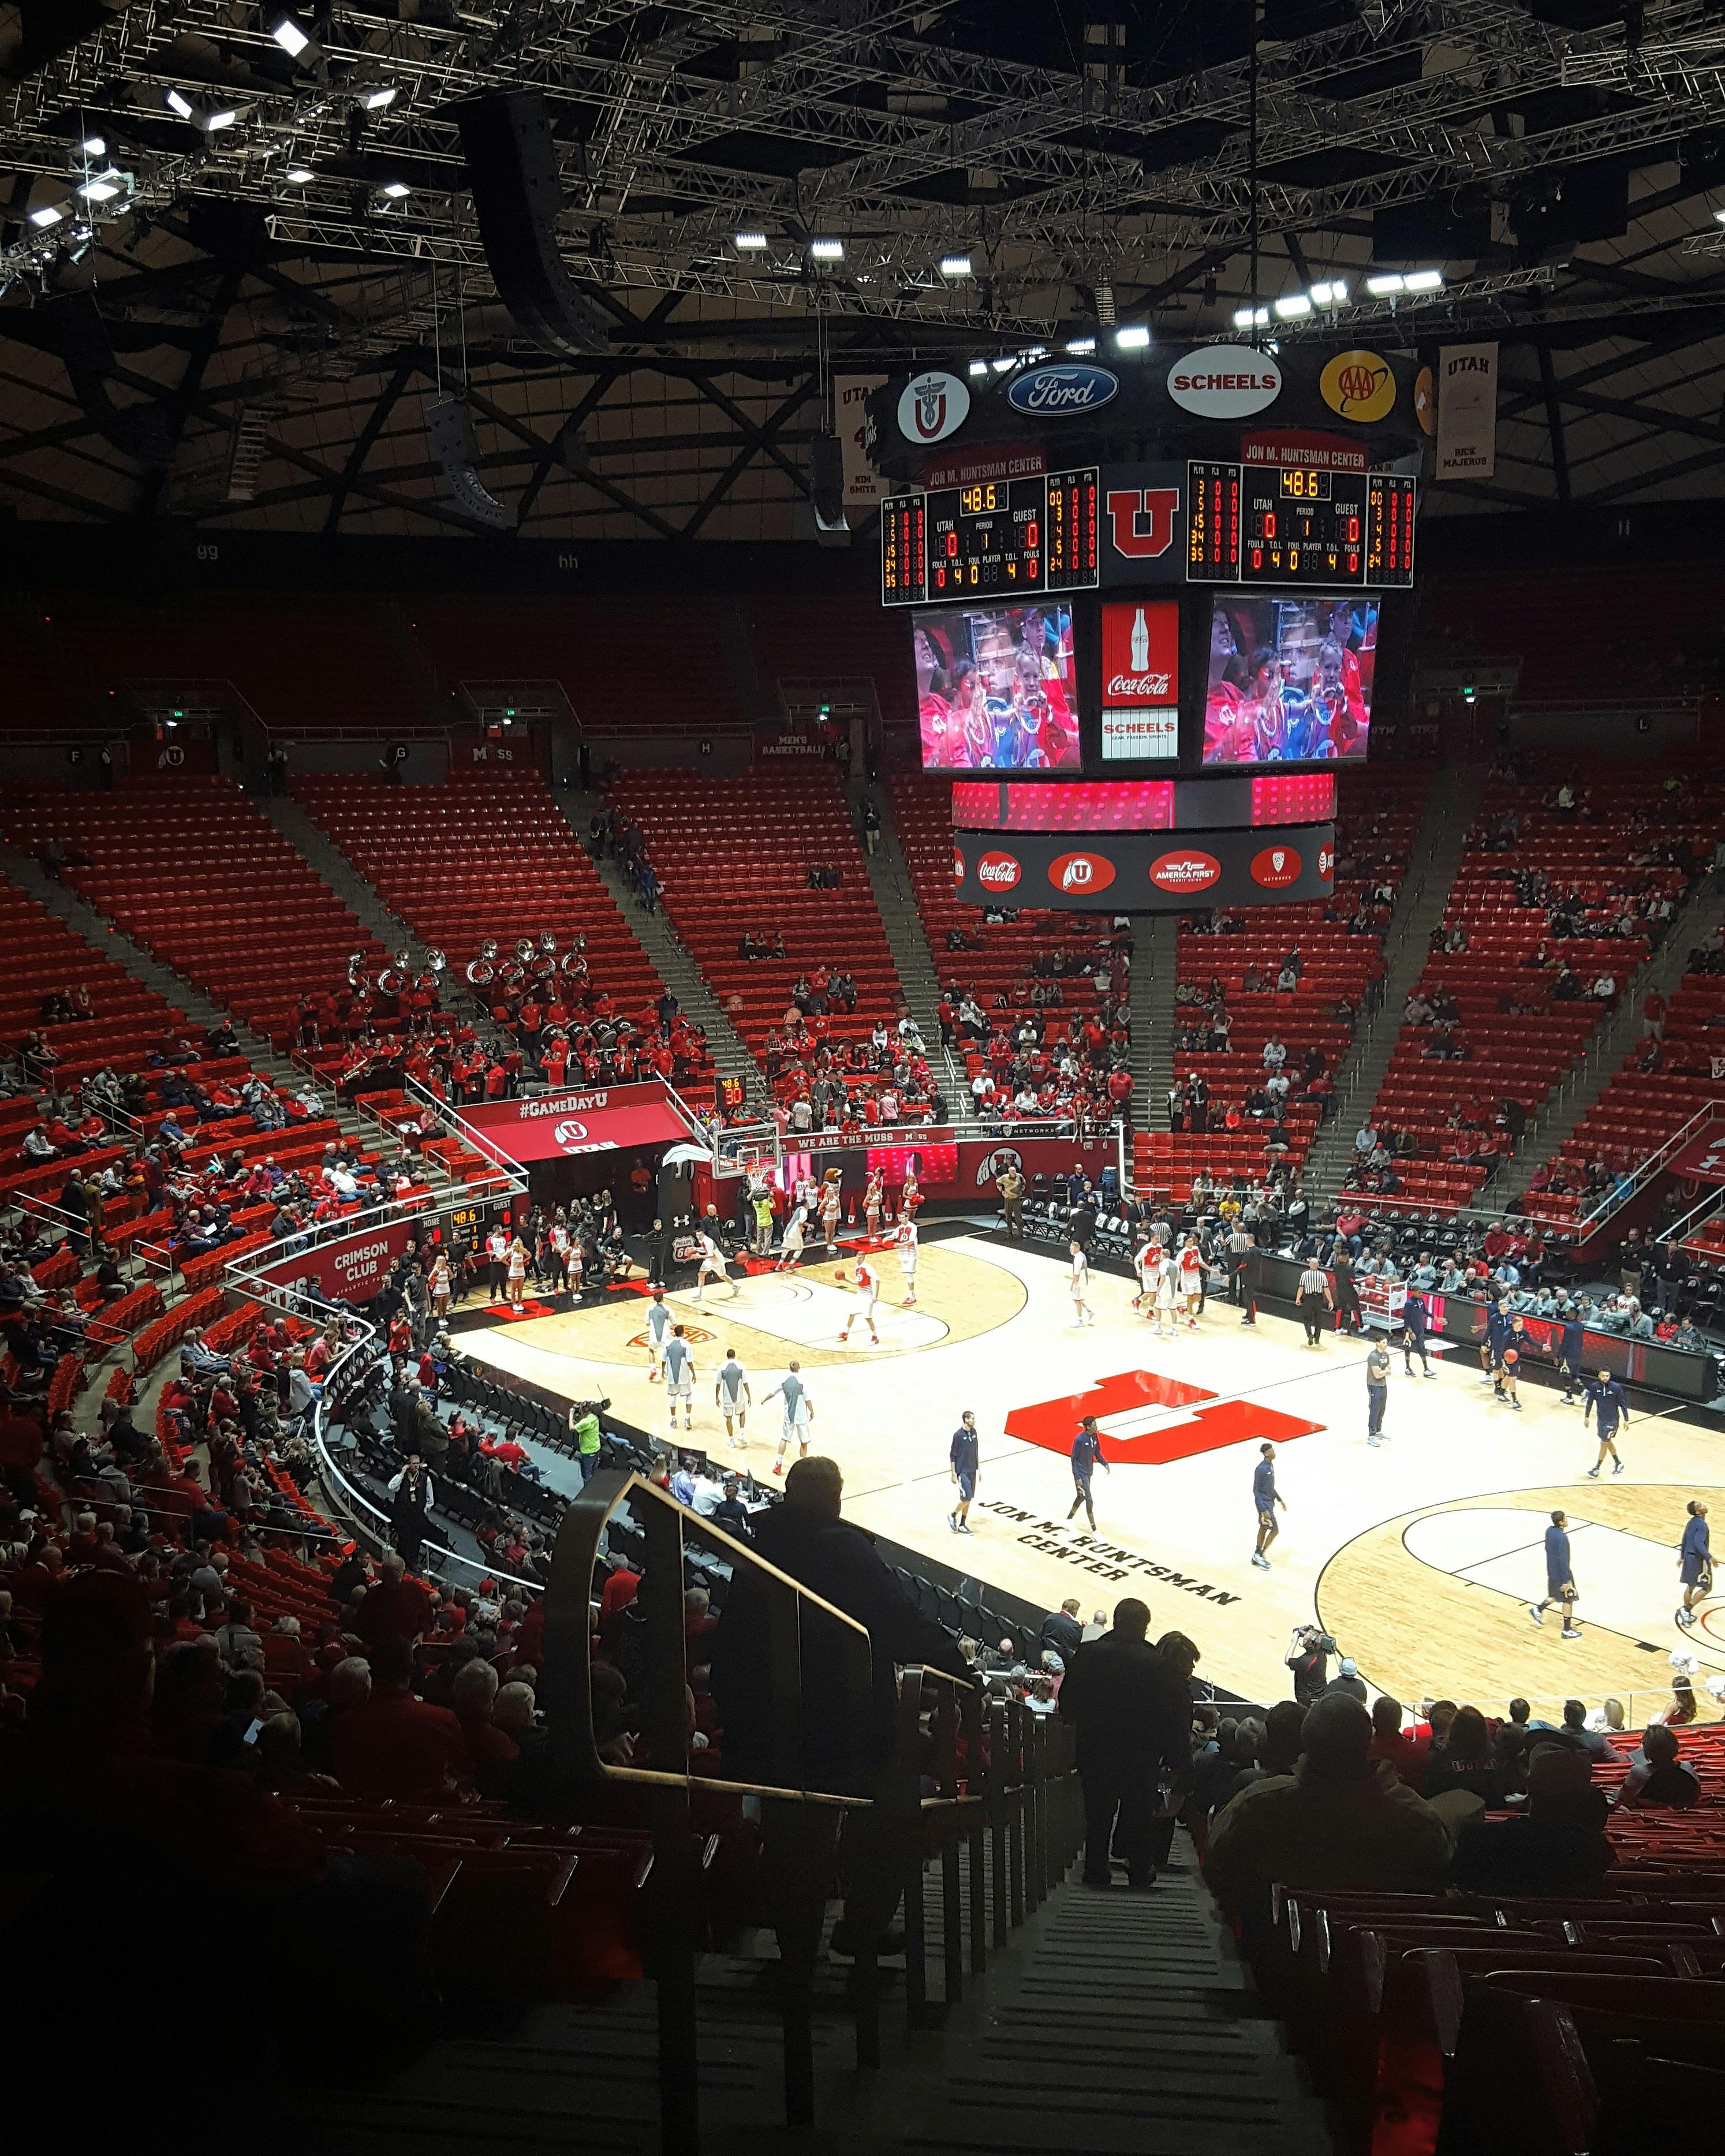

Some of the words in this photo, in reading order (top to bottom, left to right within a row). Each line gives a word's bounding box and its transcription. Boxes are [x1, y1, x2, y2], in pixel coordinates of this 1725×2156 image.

[1448, 356, 1489, 376] UTAH
[1028, 372, 1096, 407] Ford
[1174, 374, 1276, 392] SCHEELS
[1339, 367, 1375, 399] AAA
[1246, 445, 1264, 460] JON
[1266, 447, 1278, 461] M.
[1281, 447, 1329, 464] HUNTSMAN
[1332, 451, 1364, 468] CENTER
[930, 470, 945, 486] JON
[947, 469, 958, 483] M.
[961, 461, 1006, 480] HUNTSMAN
[1009, 456, 1042, 473] CENTER
[1084, 473, 1092, 482] PTS
[1228, 468, 1236, 477] PTS
[1199, 480, 1204, 494] 3
[1283, 471, 1317, 496] 48.6
[963, 484, 996, 512] 48.6
[1050, 491, 1062, 506] 00
[1198, 496, 1204, 510] 5
[1253, 498, 1272, 510] UTAH
[1371, 491, 1383, 506] 00
[1013, 509, 1037, 522] GUEST
[1056, 507, 1062, 521] 3
[1296, 507, 1314, 516] PERIOD
[1335, 503, 1358, 515] GUEST
[1377, 507, 1382, 521] 3
[936, 520, 954, 532] UTAH
[976, 521, 993, 530] PERIOD
[1106, 487, 1181, 558] U
[1195, 513, 1204, 528] 15
[1265, 513, 1275, 538] 0
[1349, 518, 1359, 542] 0
[1056, 525, 1062, 537] 4
[1192, 530, 1204, 544] 34
[1376, 524, 1382, 536] 4
[197, 544, 219, 560] gg
[1056, 540, 1062, 554] 5
[1248, 540, 1264, 548] FOULS
[1288, 541, 1300, 550] FOUL
[1303, 542, 1321, 551] PLAYER
[1345, 544, 1360, 553] FOULS
[1376, 538, 1382, 552] 5
[932, 561, 947, 569] FOULS
[968, 556, 981, 565] FOUL
[983, 554, 1000, 563] PLAYER
[1024, 550, 1040, 559] FOULS
[1192, 547, 1204, 561] 35
[1253, 550, 1263, 569] 0
[1272, 551, 1280, 569] 4
[1290, 551, 1298, 570] 0
[1329, 554, 1336, 570] 4
[1349, 553, 1358, 572] 0
[558, 554, 578, 569] hh
[1050, 558, 1062, 571] 24
[1369, 554, 1382, 569] 24
[954, 569, 961, 585] 4
[1008, 562, 1015, 579] 4
[1103, 722, 1175, 734] SCHEELS
[397, 747, 406, 758] G
[701, 743, 711, 753] H
[71, 751, 80, 763] F
[1074, 864, 1088, 880] U
[1156, 870, 1191, 879] AMERICA
[1192, 870, 1215, 878] FIRST
[722, 1077, 740, 1088] 48.6
[725, 1086, 743, 1107] 30
[562, 1123, 584, 1138] U
[562, 1141, 621, 1155] UTAH
[797, 1139, 816, 1149] WE
[817, 1136, 839, 1147] ARE
[842, 1134, 862, 1145] THE
[865, 1133, 894, 1144] MUSS
[493, 1199, 511, 1211] GUEST
[423, 1216, 440, 1229] HOME
[453, 1208, 476, 1225] 48.6
[502, 1210, 511, 1225] 0
[334, 1240, 389, 1271] CRIMSON
[346, 1260, 378, 1282] CLUB
[978, 1501, 1037, 1522] JON
[1030, 1521, 1066, 1537] M.
[1068, 1535, 1242, 1606] HUNTSMAN
[1017, 1534, 1129, 1582] CENTER
